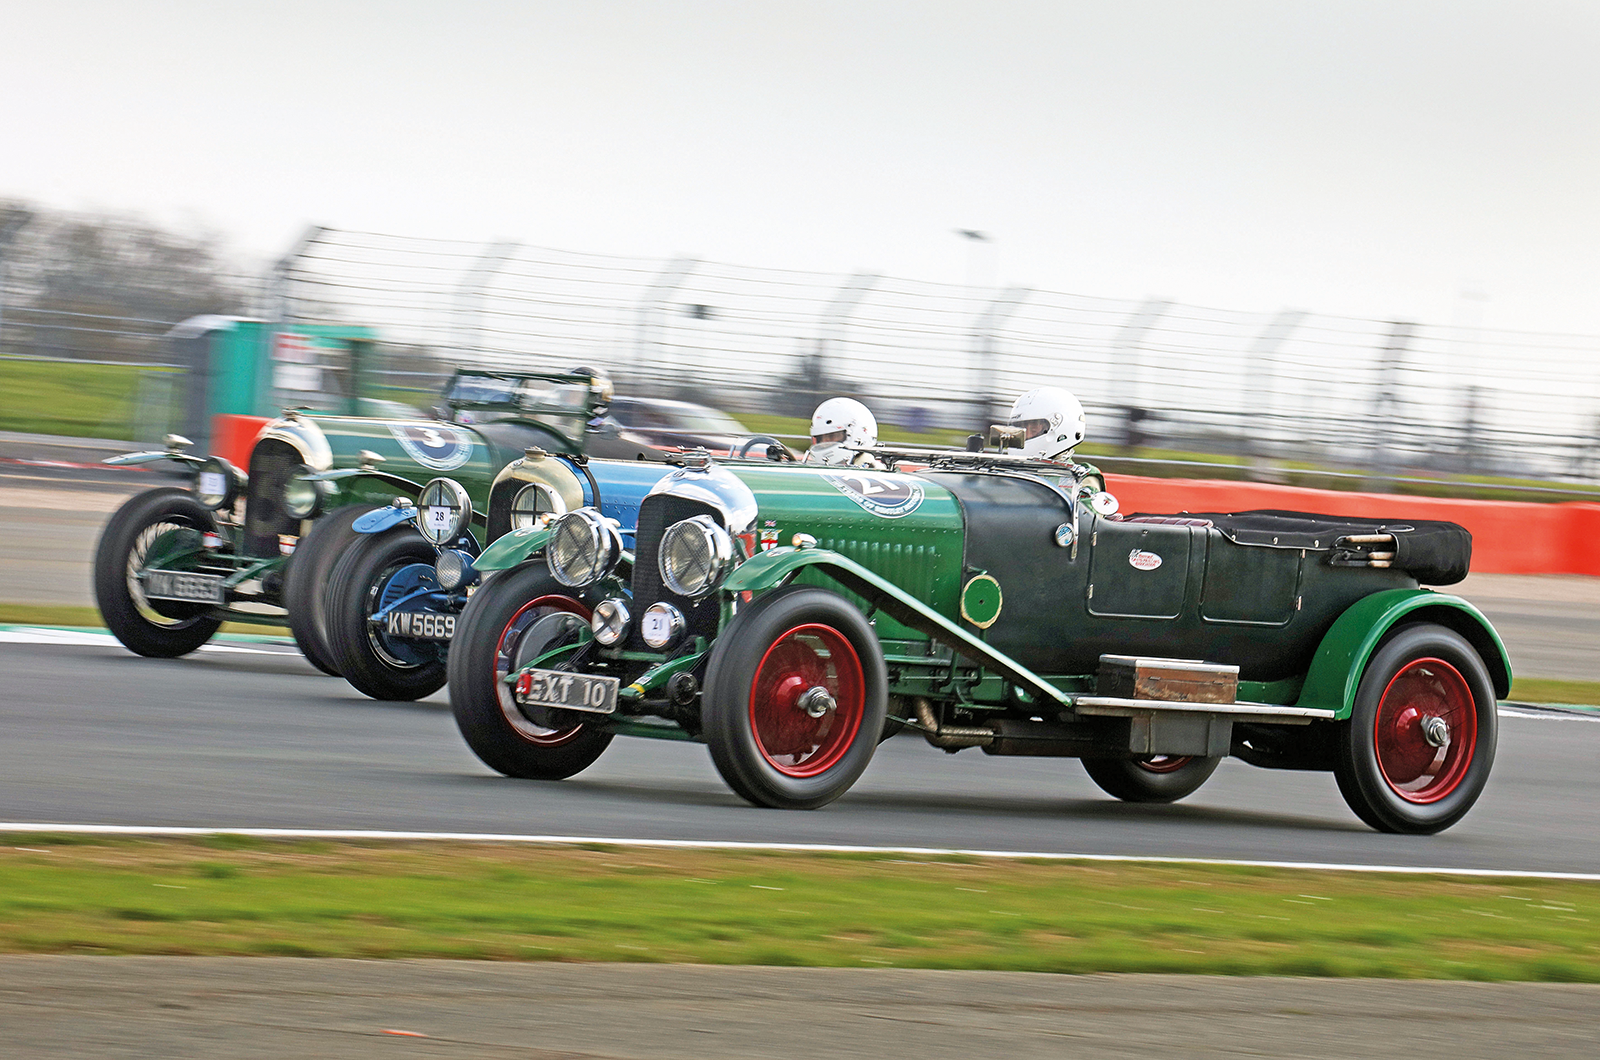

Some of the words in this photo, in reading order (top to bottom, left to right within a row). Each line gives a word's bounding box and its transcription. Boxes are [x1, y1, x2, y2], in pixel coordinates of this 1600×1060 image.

[414, 427, 446, 448] 3
[841, 475, 900, 495] 21
[435, 511, 445, 521] 28
[652, 618, 663, 630] 21
[527, 671, 574, 703] EXT
